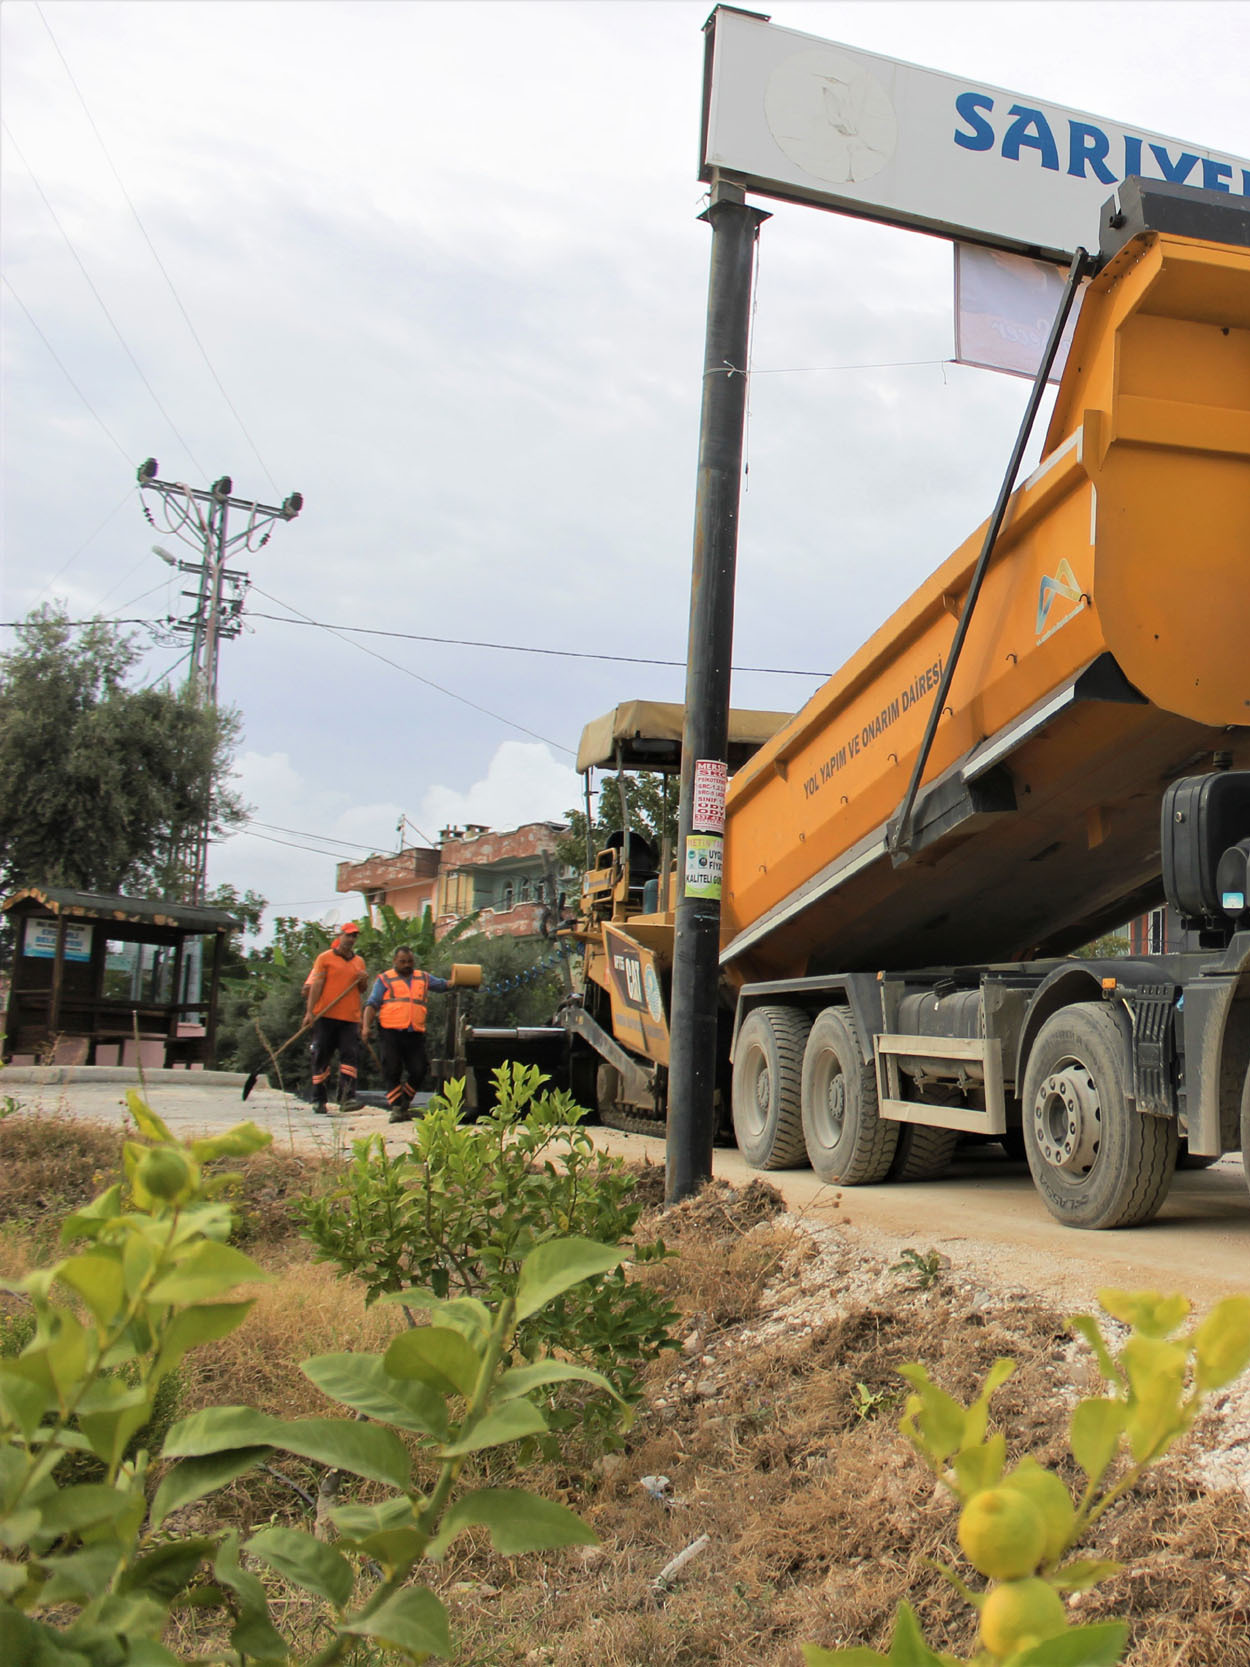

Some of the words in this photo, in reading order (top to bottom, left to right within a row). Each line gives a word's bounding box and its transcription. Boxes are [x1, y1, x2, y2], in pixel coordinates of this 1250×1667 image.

[803, 774, 819, 800] YOL
[820, 747, 847, 784] YAPIM
[848, 734, 861, 759] VE
[862, 698, 900, 748] ONARIM
[901, 652, 944, 713] DAİRESİ
